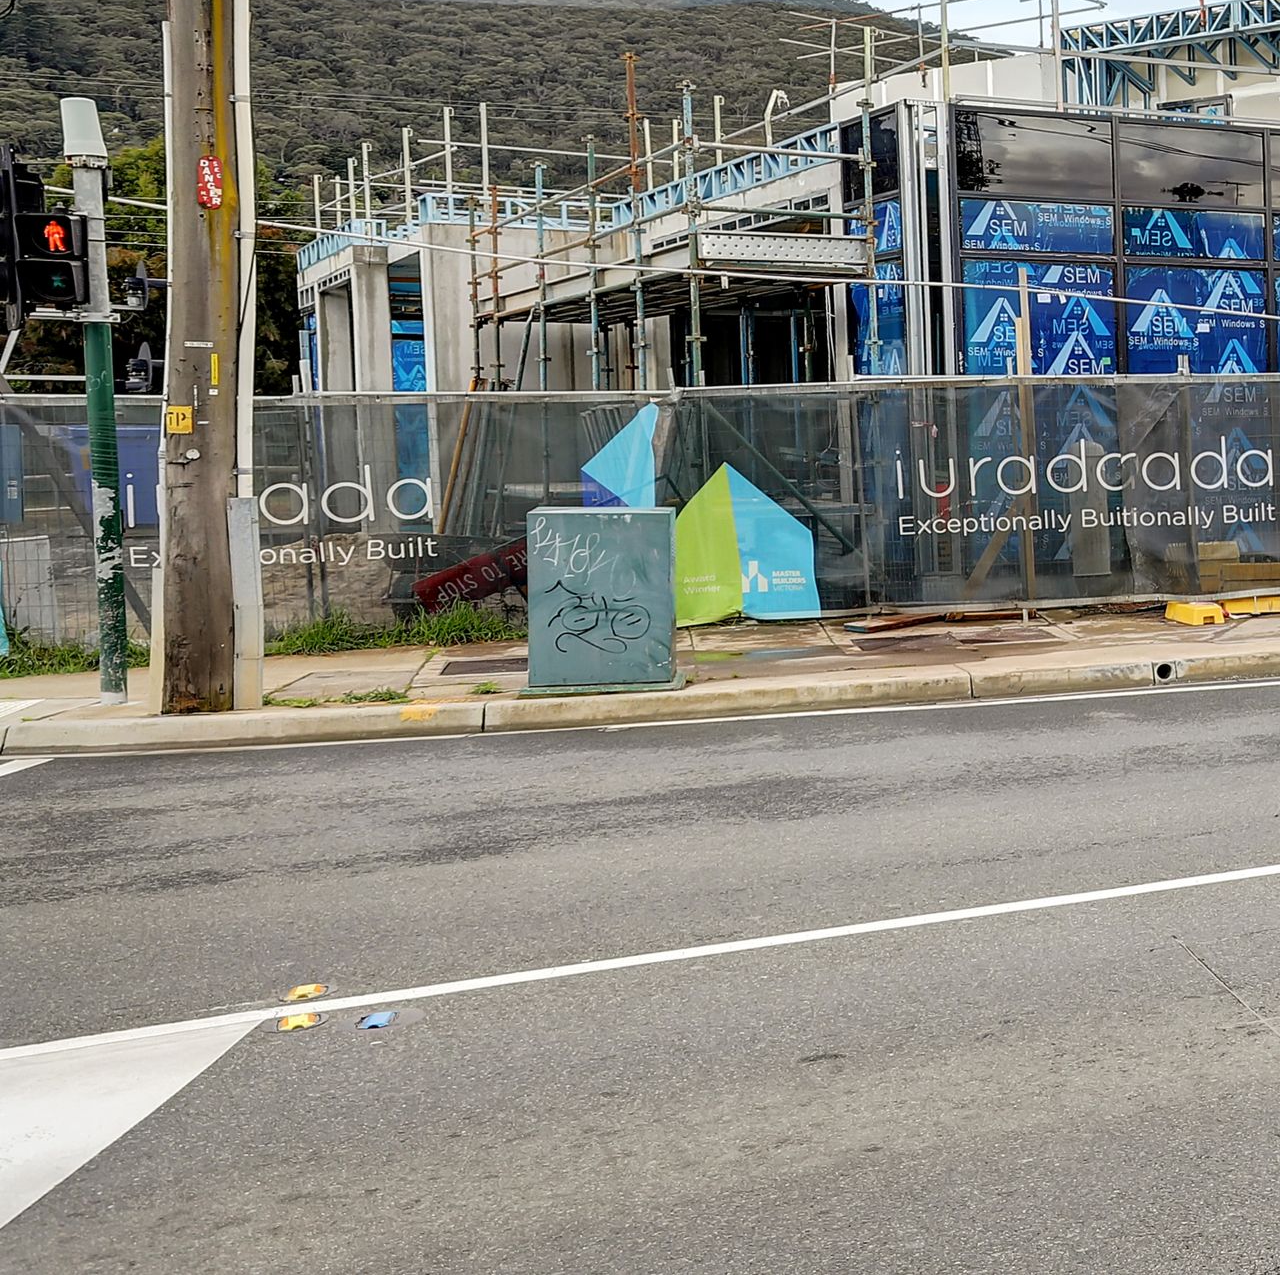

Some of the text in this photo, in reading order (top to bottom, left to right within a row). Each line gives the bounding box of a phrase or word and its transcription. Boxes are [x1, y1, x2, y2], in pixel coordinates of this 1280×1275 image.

[1038, 213, 1058, 222] SEM
[1064, 214, 1101, 225] Windows
[990, 220, 1027, 236] SEM
[965, 240, 1041, 251] SEM Windows S
[1064, 267, 1100, 284] SEM
[1222, 319, 1255, 329] Windows
[1260, 320, 1265, 328] S
[1129, 336, 1147, 345] SEM
[968, 347, 988, 356] SEM
[1069, 359, 1105, 374] SEM
[1223, 387, 1258, 403] SEM
[168, 412, 186, 426] TP
[898, 509, 1072, 536] Exceptionally
[1223, 503, 1276, 524] Built
[366, 536, 439, 560] Built
[437, 563, 506, 602] TO STOP
[683, 574, 716, 584] Award
[684, 585, 720, 595] Winner
